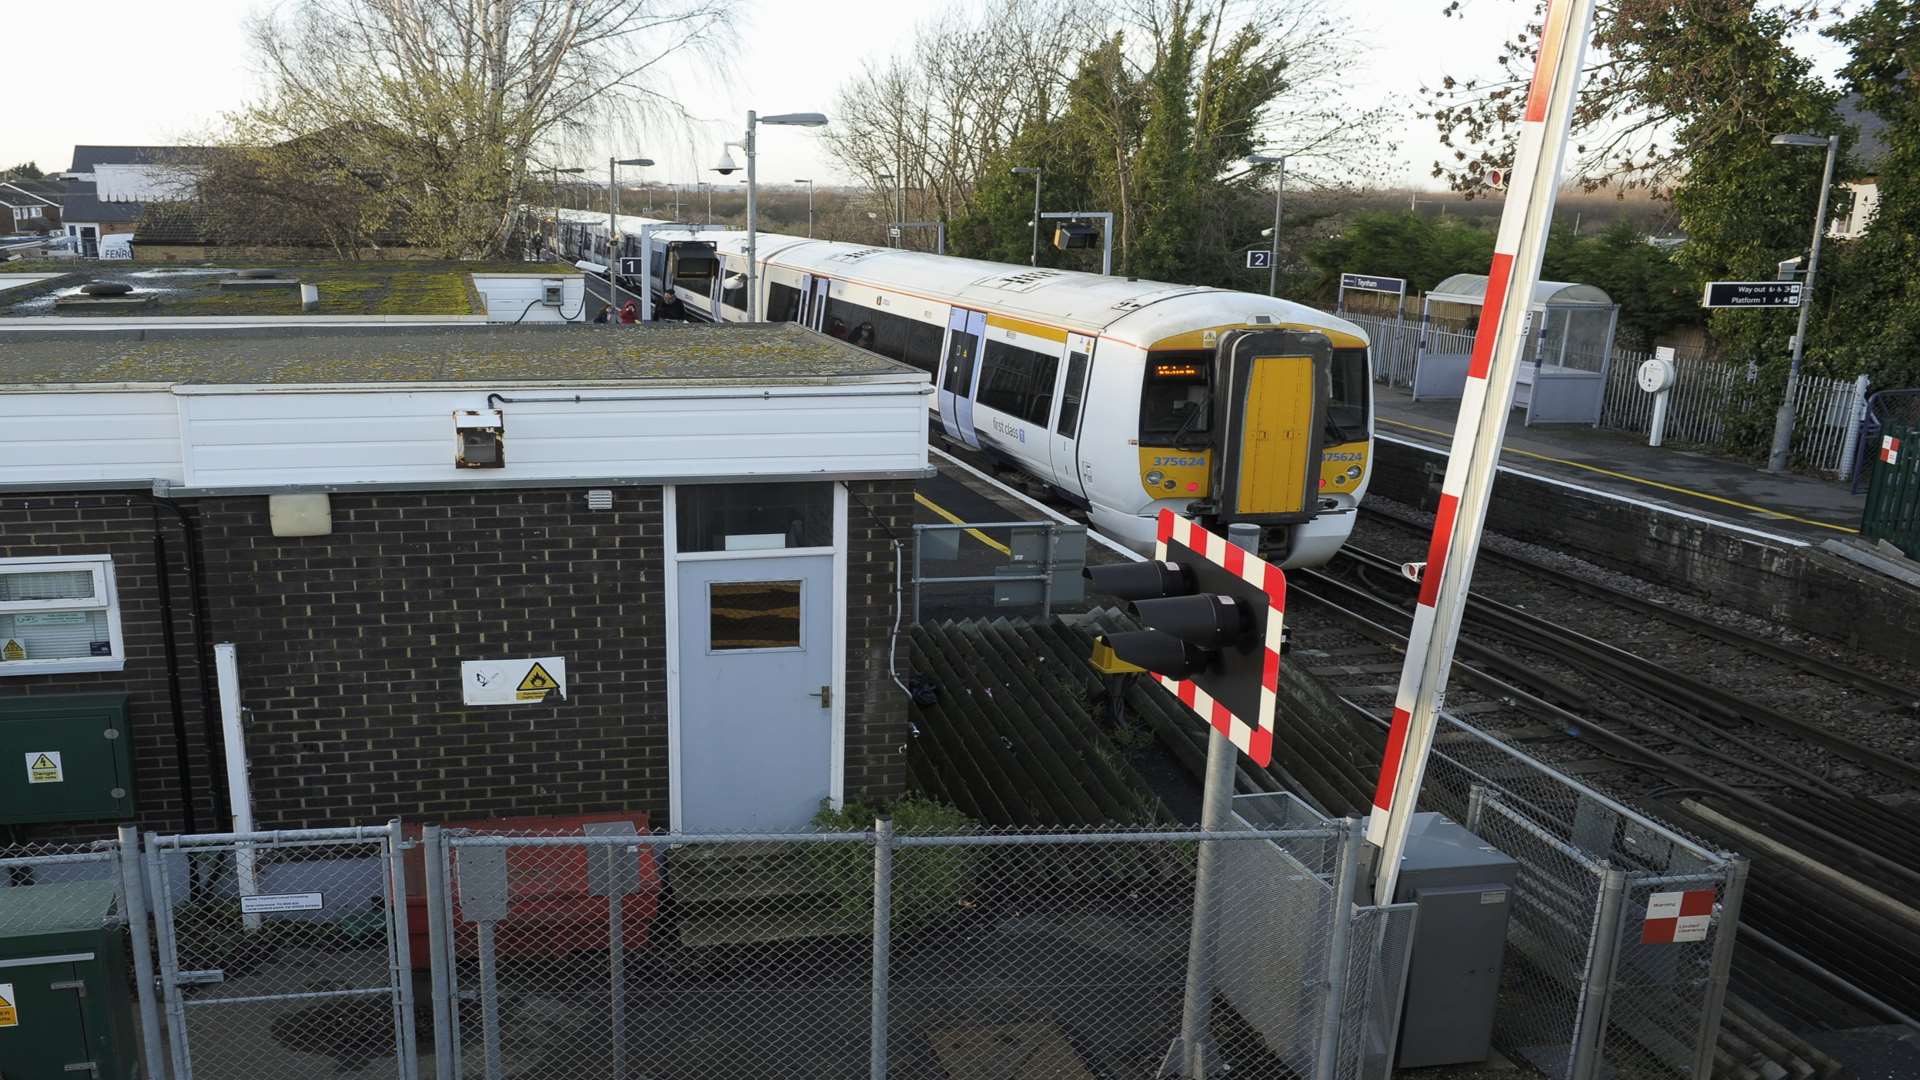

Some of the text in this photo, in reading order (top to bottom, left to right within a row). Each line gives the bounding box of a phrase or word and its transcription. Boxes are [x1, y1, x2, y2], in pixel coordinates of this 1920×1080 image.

[1254, 253, 1265, 266] 2
[626, 260, 634, 273] 1
[1738, 286, 1752, 294] Way
[992, 416, 1004, 434] first
[1004, 422, 1019, 440] class
[1153, 457, 1206, 466] 375624
